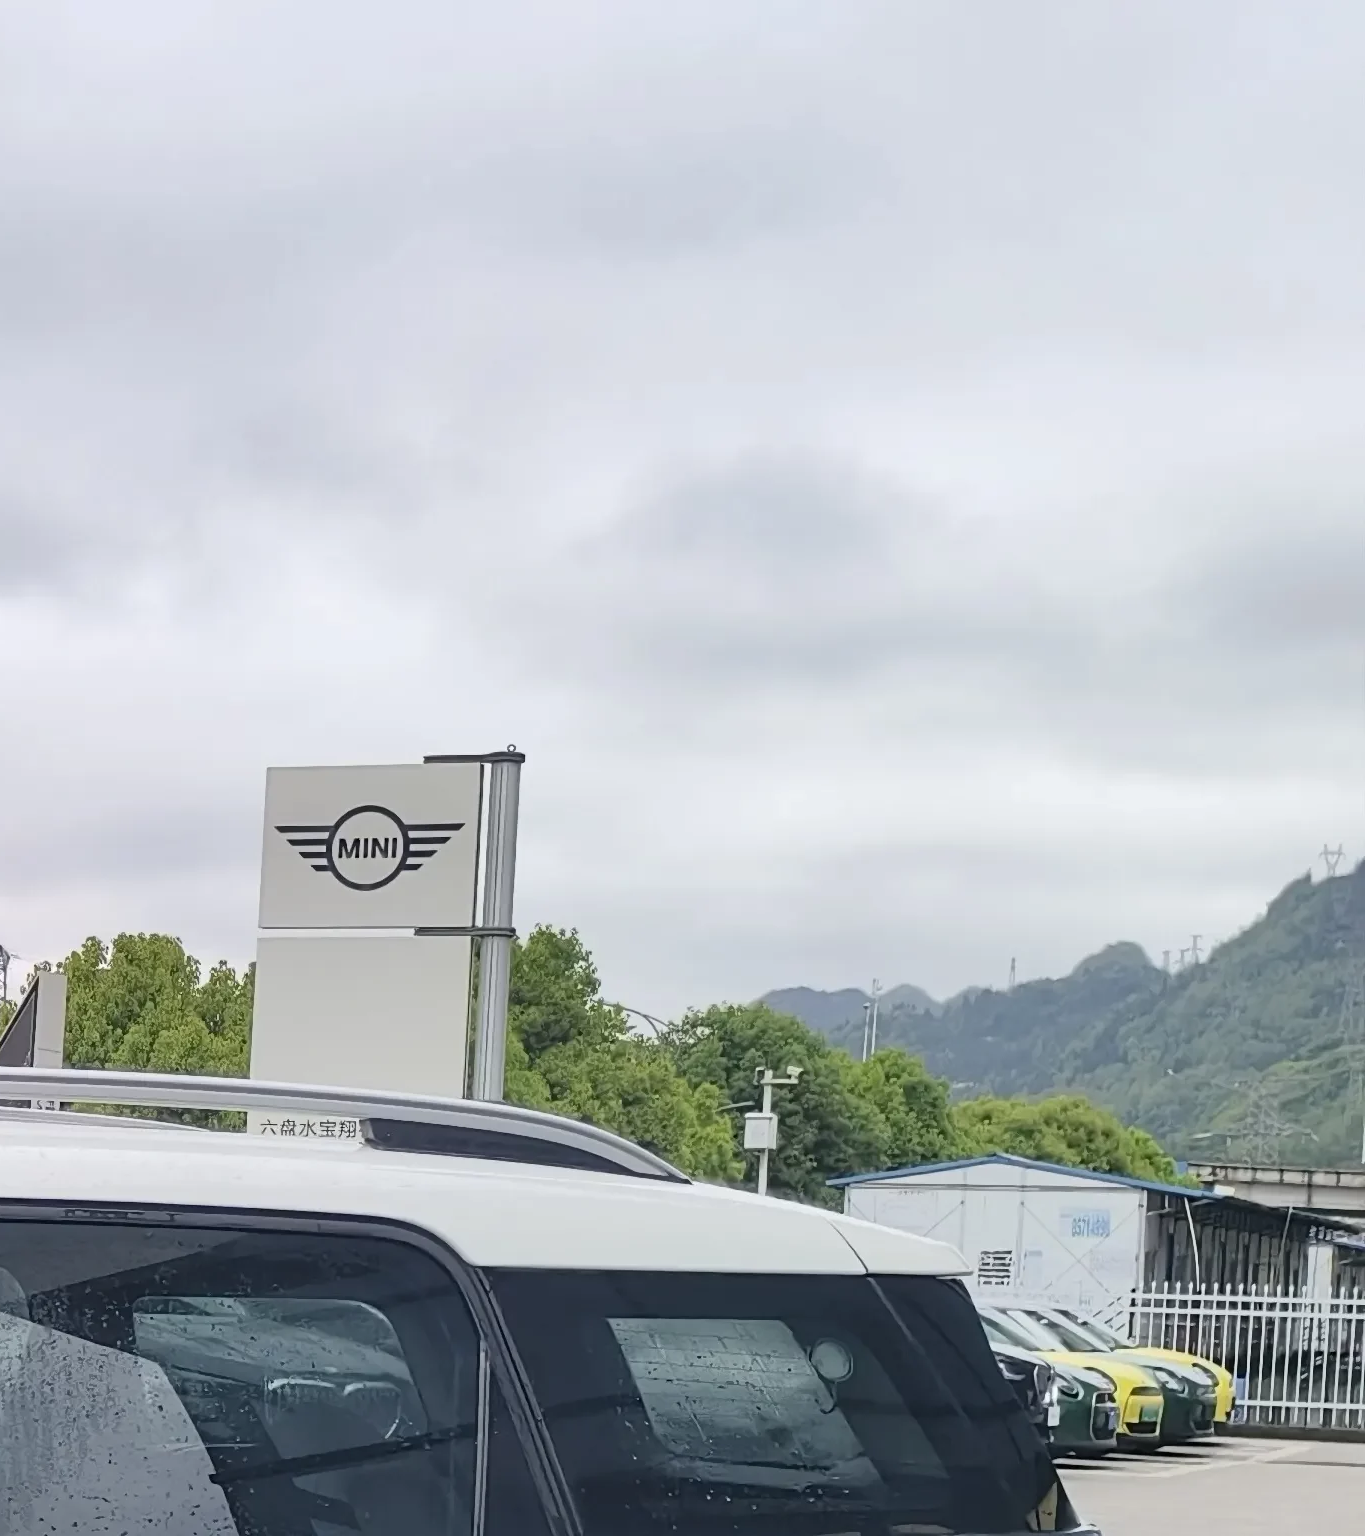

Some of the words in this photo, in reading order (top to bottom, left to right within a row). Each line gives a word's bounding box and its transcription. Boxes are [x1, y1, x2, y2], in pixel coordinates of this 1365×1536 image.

[338, 837, 398, 859] MINI
[260, 1119, 357, 1138] 六盘水宝翔
